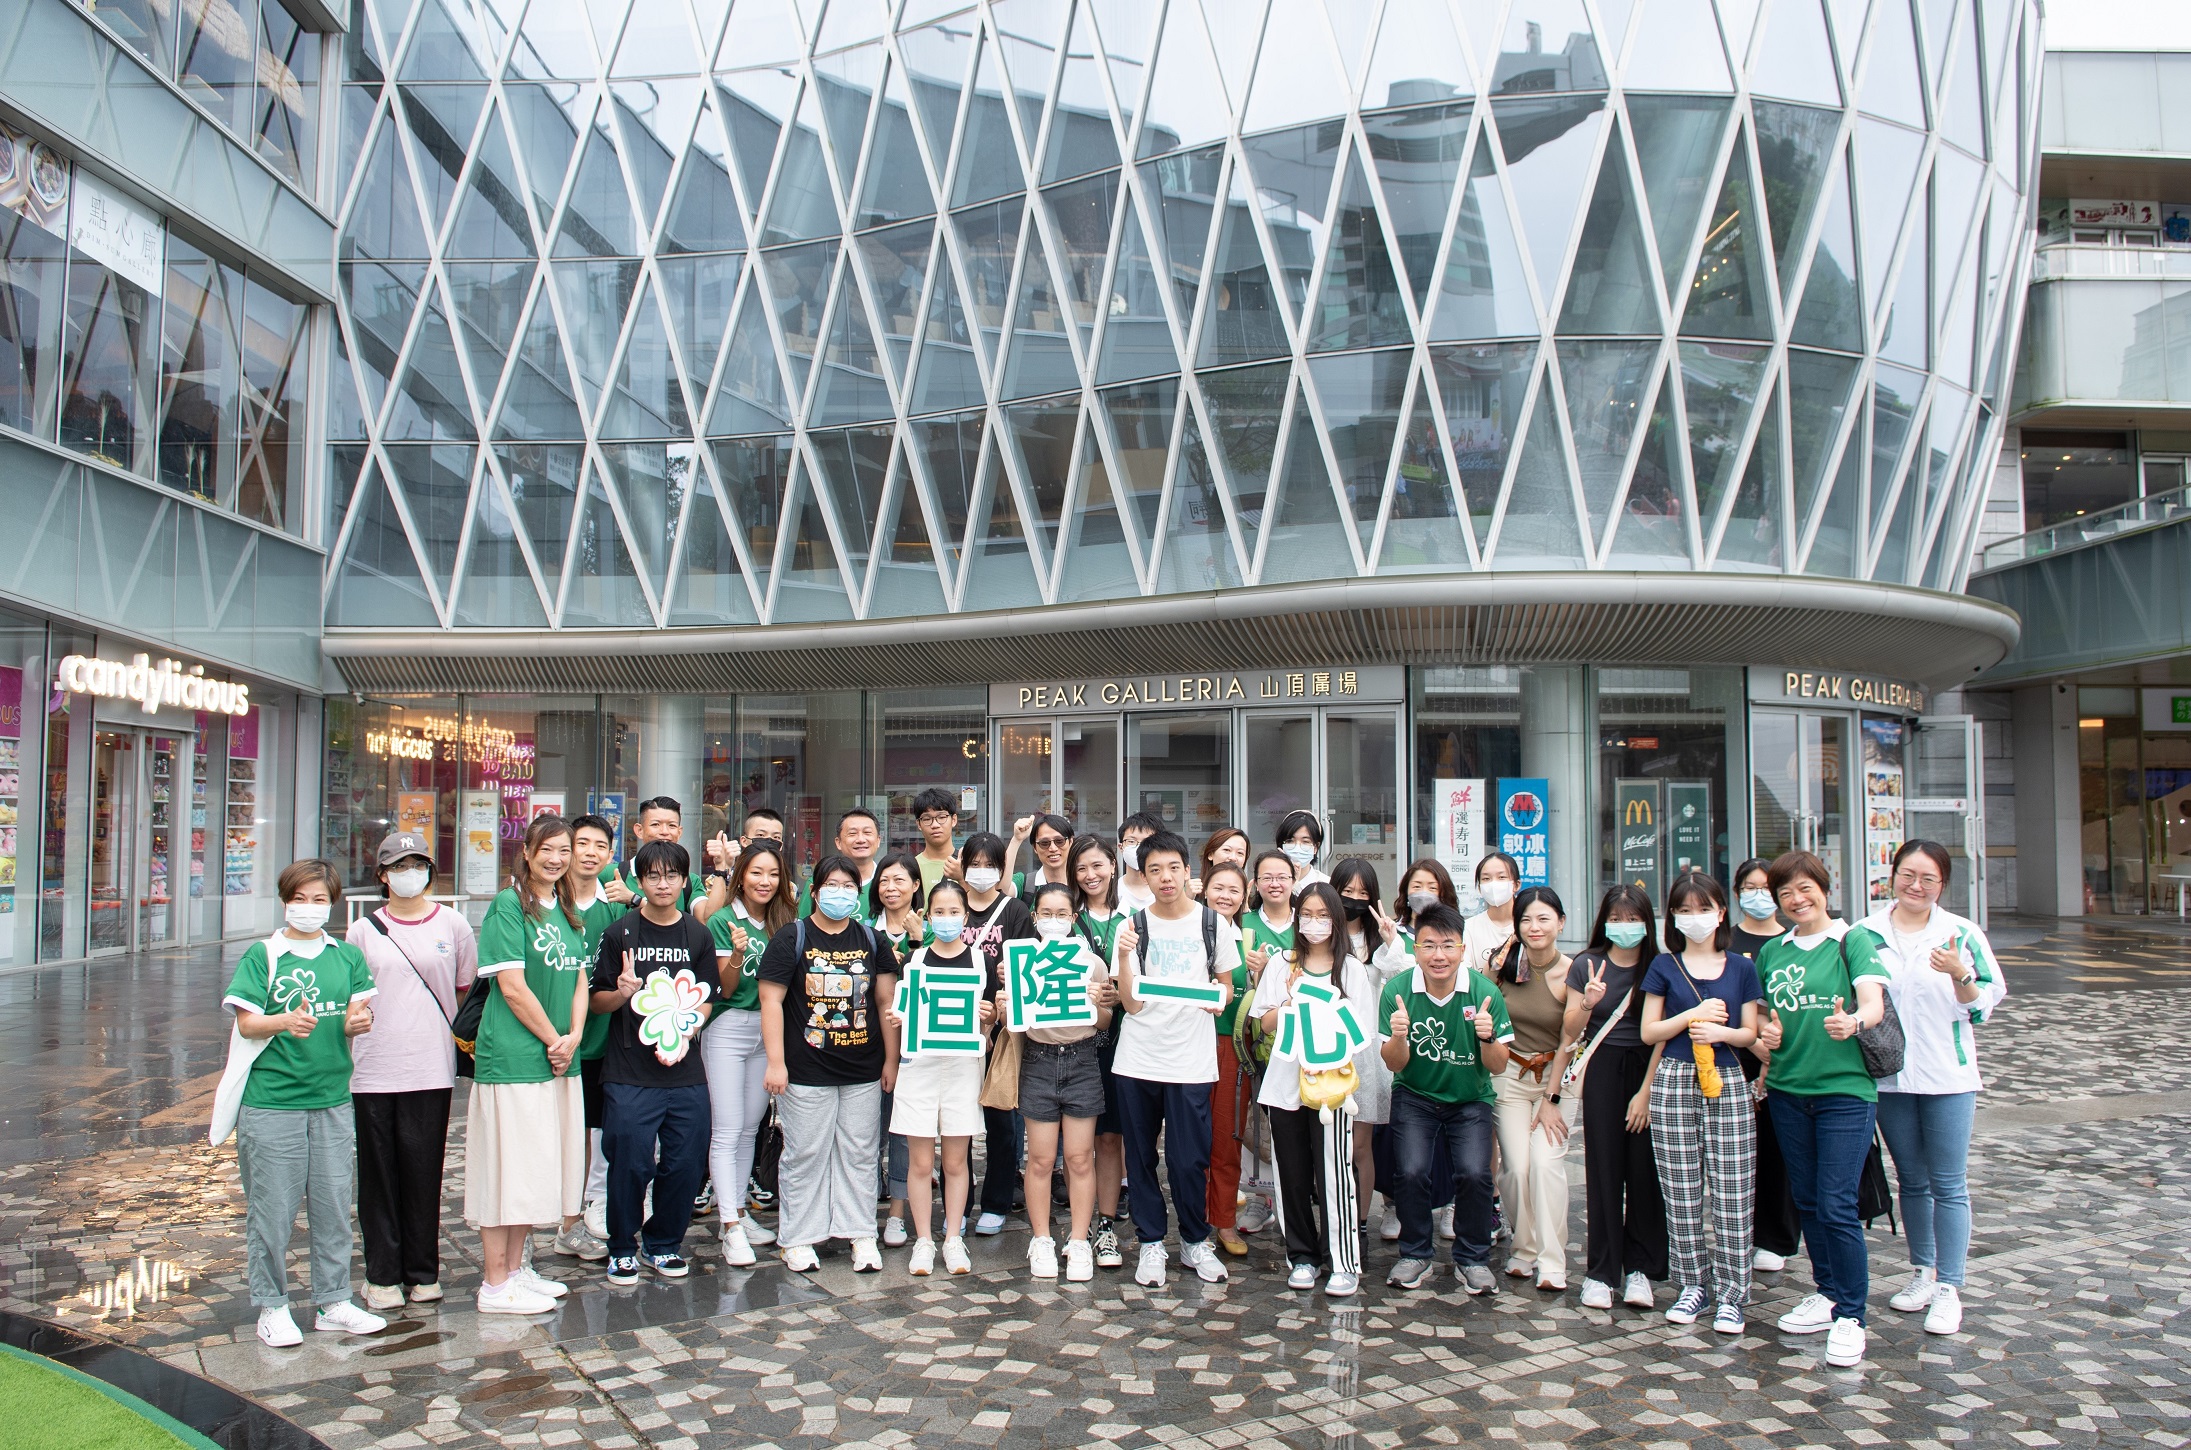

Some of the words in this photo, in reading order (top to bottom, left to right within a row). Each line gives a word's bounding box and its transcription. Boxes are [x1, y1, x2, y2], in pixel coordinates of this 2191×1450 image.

[88, 196, 156, 266] 點心廊
[59, 653, 249, 716] candylicious
[1019, 684, 1086, 709] PEAK
[1101, 677, 1246, 703] GALLERIA
[1260, 671, 1358, 697] 山頂廣場
[1786, 672, 1842, 699] PEAK
[1850, 678, 1911, 707] GALLERIA
[832, 949, 869, 961] SNOOPY
[898, 969, 980, 1052] 恒
[1009, 940, 1091, 1026] 隆
[1138, 983, 1220, 1002] 一
[1279, 983, 1364, 1064] 心
[829, 1031, 847, 1040] The
[850, 1029, 867, 1038] Best
[834, 1037, 868, 1046] Partner
